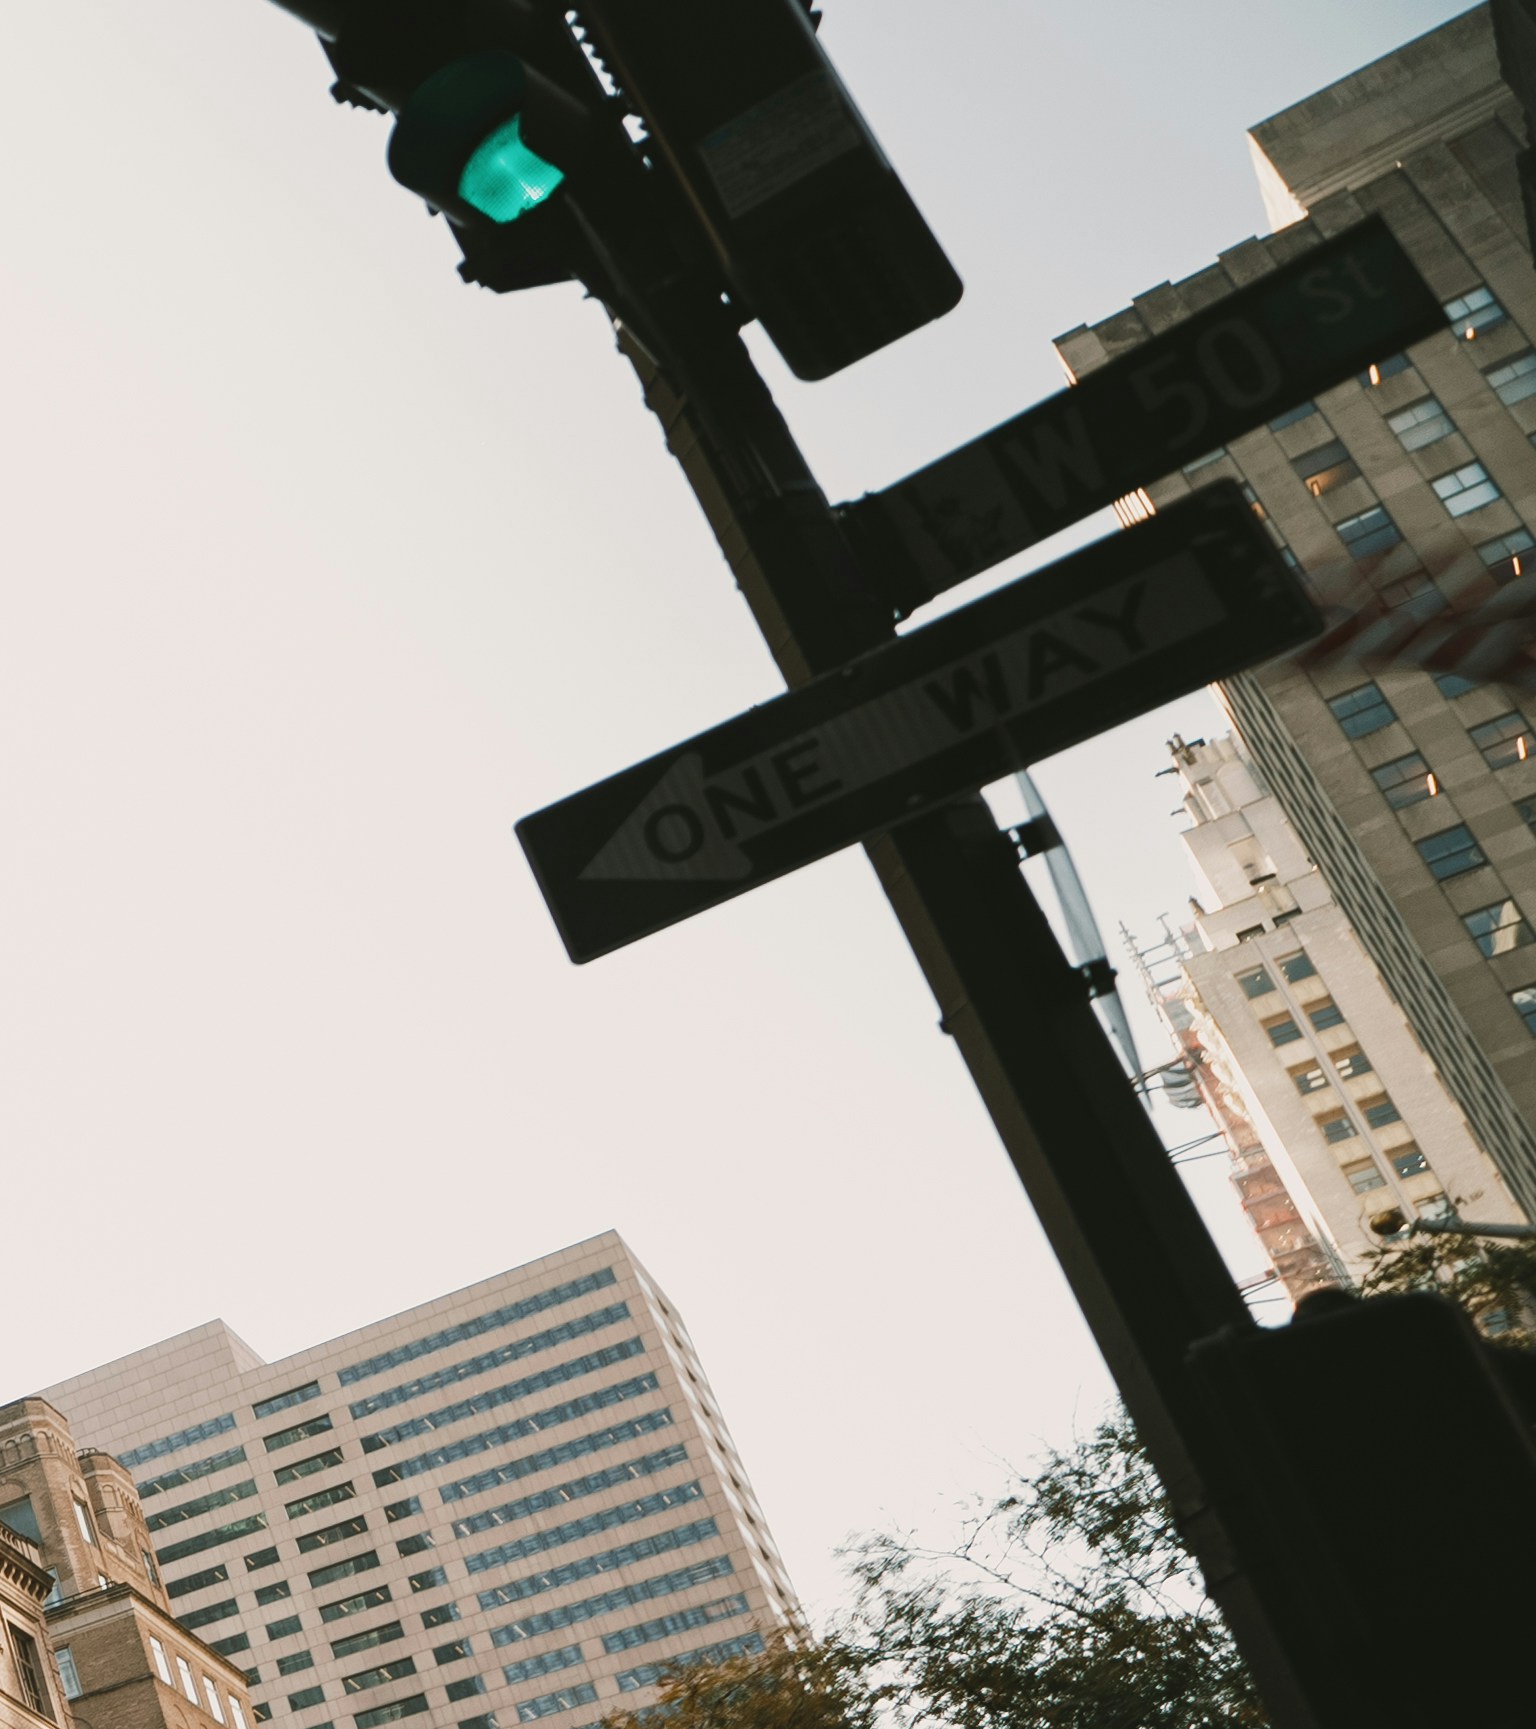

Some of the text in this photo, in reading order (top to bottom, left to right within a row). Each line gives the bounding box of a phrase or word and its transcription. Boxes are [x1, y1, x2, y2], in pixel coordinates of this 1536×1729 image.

[1003, 250, 1388, 511] W 50 St
[642, 582, 1154, 864] ONE WAY
